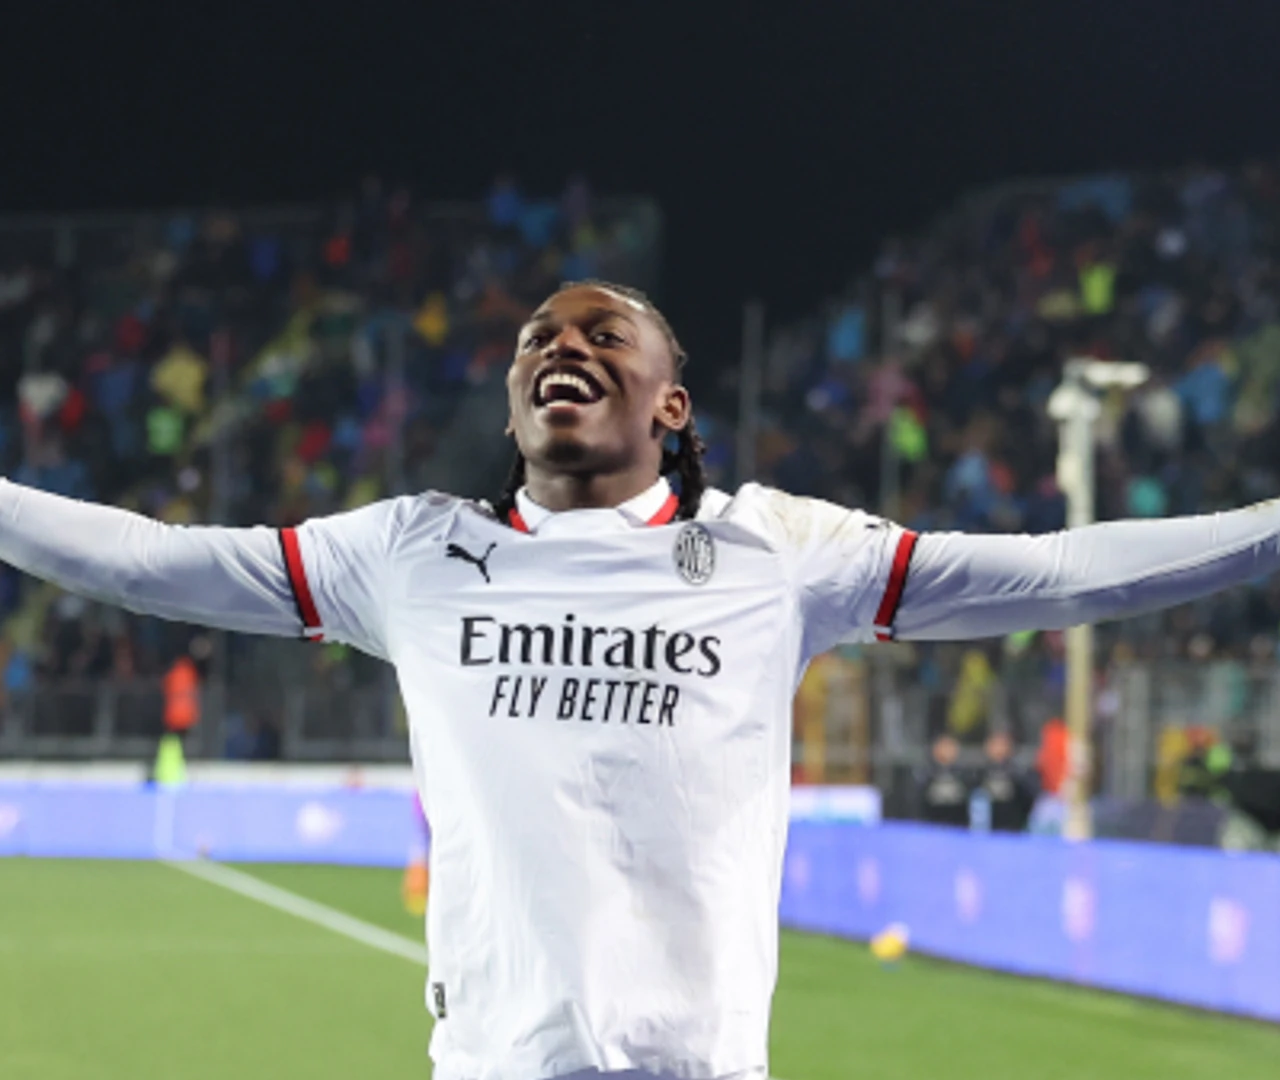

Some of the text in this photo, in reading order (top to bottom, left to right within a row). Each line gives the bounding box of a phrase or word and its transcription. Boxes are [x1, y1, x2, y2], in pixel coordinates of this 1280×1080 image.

[460, 613, 721, 677] Emirates
[489, 675, 680, 726] FLY BETTER
